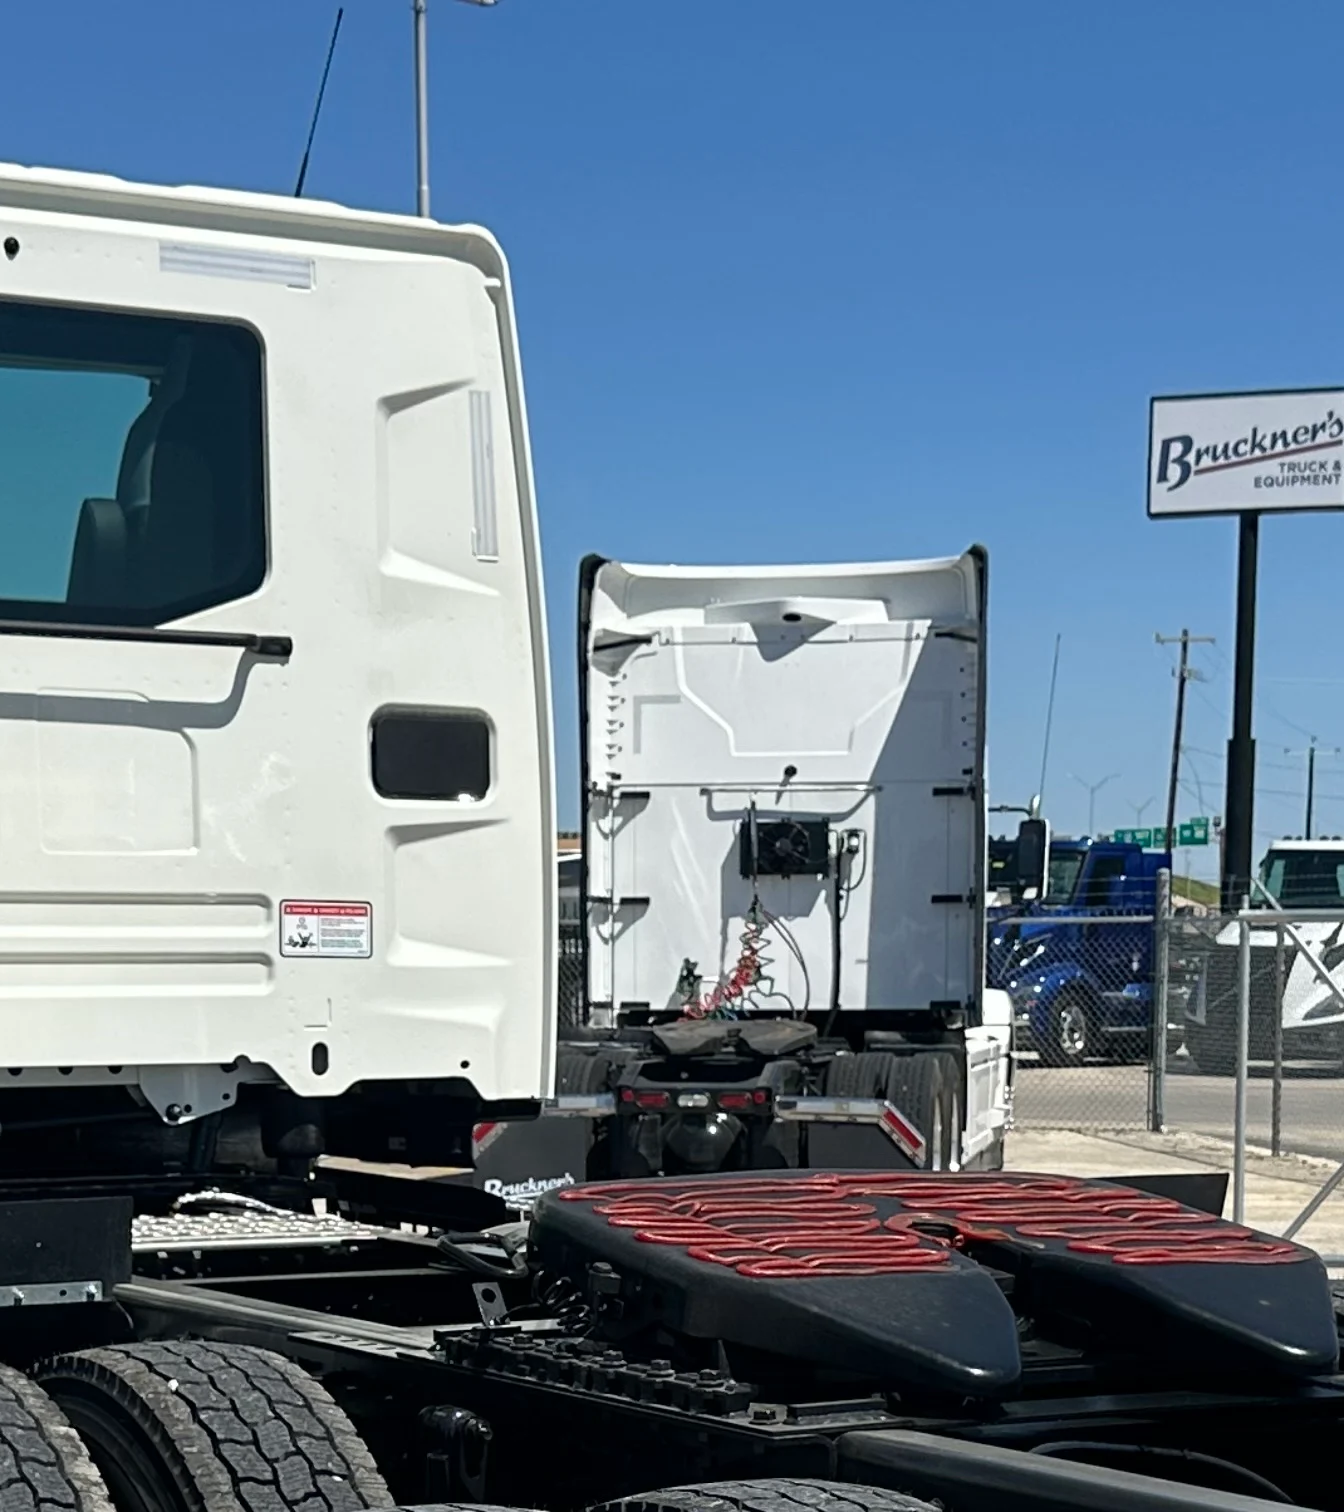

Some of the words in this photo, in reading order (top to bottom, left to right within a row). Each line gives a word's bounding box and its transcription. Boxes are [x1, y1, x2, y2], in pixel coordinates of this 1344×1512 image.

[1156, 410, 1344, 493] Bruckner's
[1278, 461, 1329, 474] TRUCK
[1332, 460, 1342, 472] &
[1253, 473, 1342, 489] EQUIPMENT
